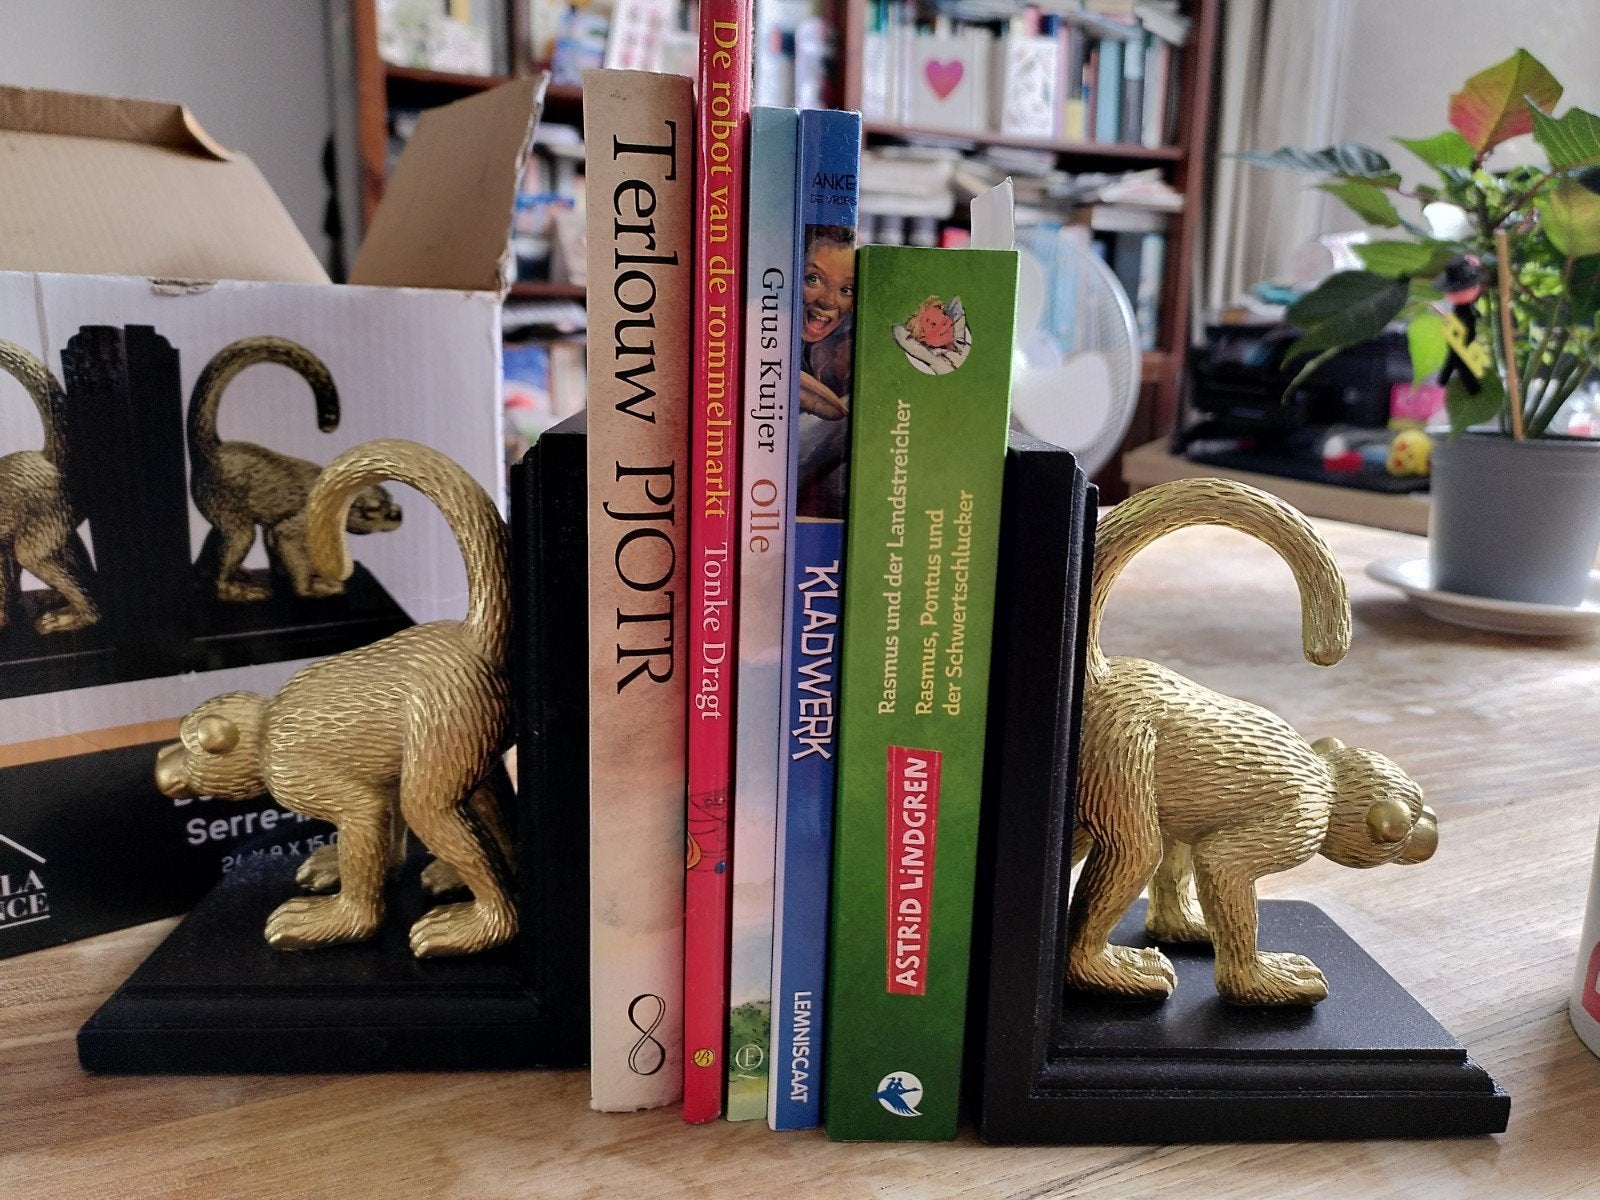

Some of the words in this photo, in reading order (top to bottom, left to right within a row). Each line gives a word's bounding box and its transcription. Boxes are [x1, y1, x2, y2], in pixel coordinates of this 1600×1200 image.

[712, 19, 739, 69] De
[711, 80, 738, 176] robot
[709, 185, 728, 243] van
[812, 172, 857, 190] ANKE
[613, 120, 679, 424] Terlouw
[708, 254, 735, 294] de
[760, 267, 785, 350] Guus
[705, 304, 732, 518] rommelmarkt
[750, 359, 783, 453] Kuijer
[886, 399, 911, 547] Landstreicher
[749, 478, 781, 553] Olle
[925, 509, 944, 550] und
[602, 460, 676, 695] PJOTR
[703, 541, 728, 632] Tonke
[884, 552, 903, 587] der
[920, 554, 942, 626] Pontus
[945, 490, 974, 678] Schwertschlucker
[883, 592, 901, 632] und
[695, 641, 726, 720] Dragt
[791, 559, 839, 761] KLADWERK
[878, 635, 899, 714] Rasmus
[915, 631, 940, 715] Rasmus,
[942, 682, 962, 716] der
[790, 991, 812, 1103] LEMNISCAAT
